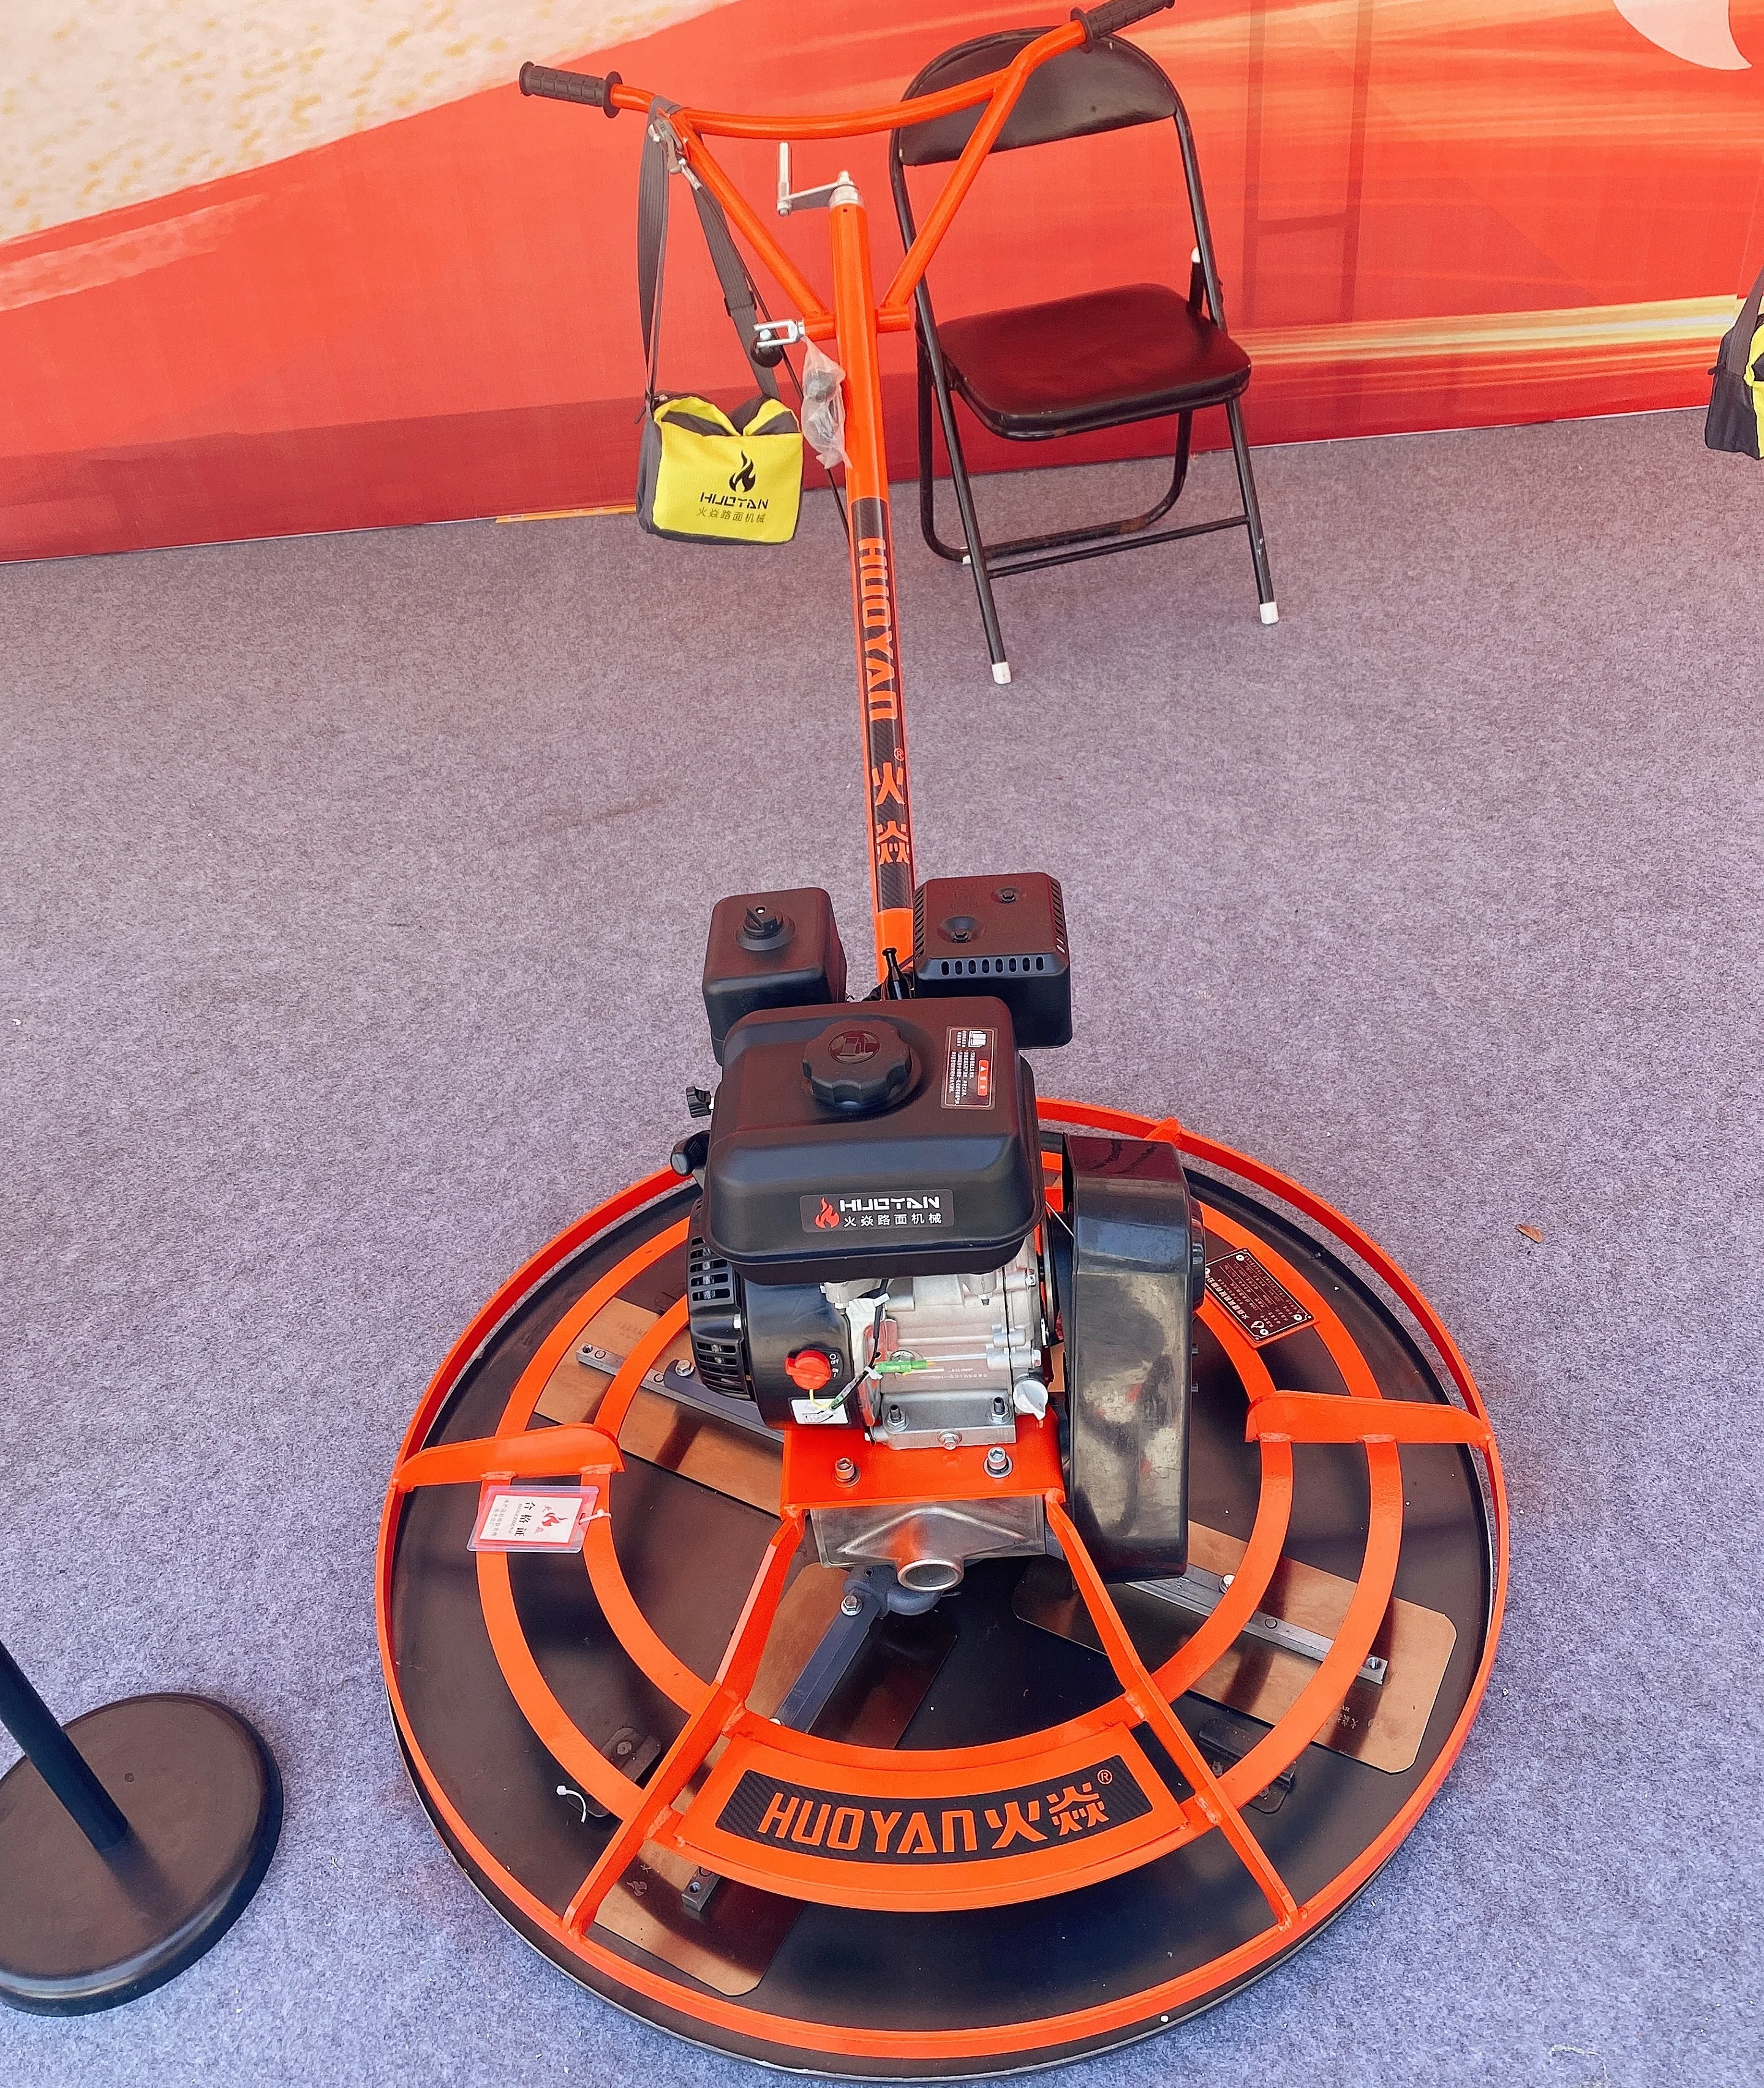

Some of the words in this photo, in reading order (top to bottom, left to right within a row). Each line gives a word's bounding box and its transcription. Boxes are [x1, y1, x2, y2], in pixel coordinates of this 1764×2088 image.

[697, 507, 766, 524] 火焱路面机械
[858, 538, 898, 722] HUOYAN
[872, 762, 910, 865] 火焱
[843, 1213, 942, 1227] 火焱路面机械
[514, 1502, 536, 1537] 合格证
[758, 1792, 977, 1853] HUOYAN
[984, 1782, 1109, 1849] 火焱
